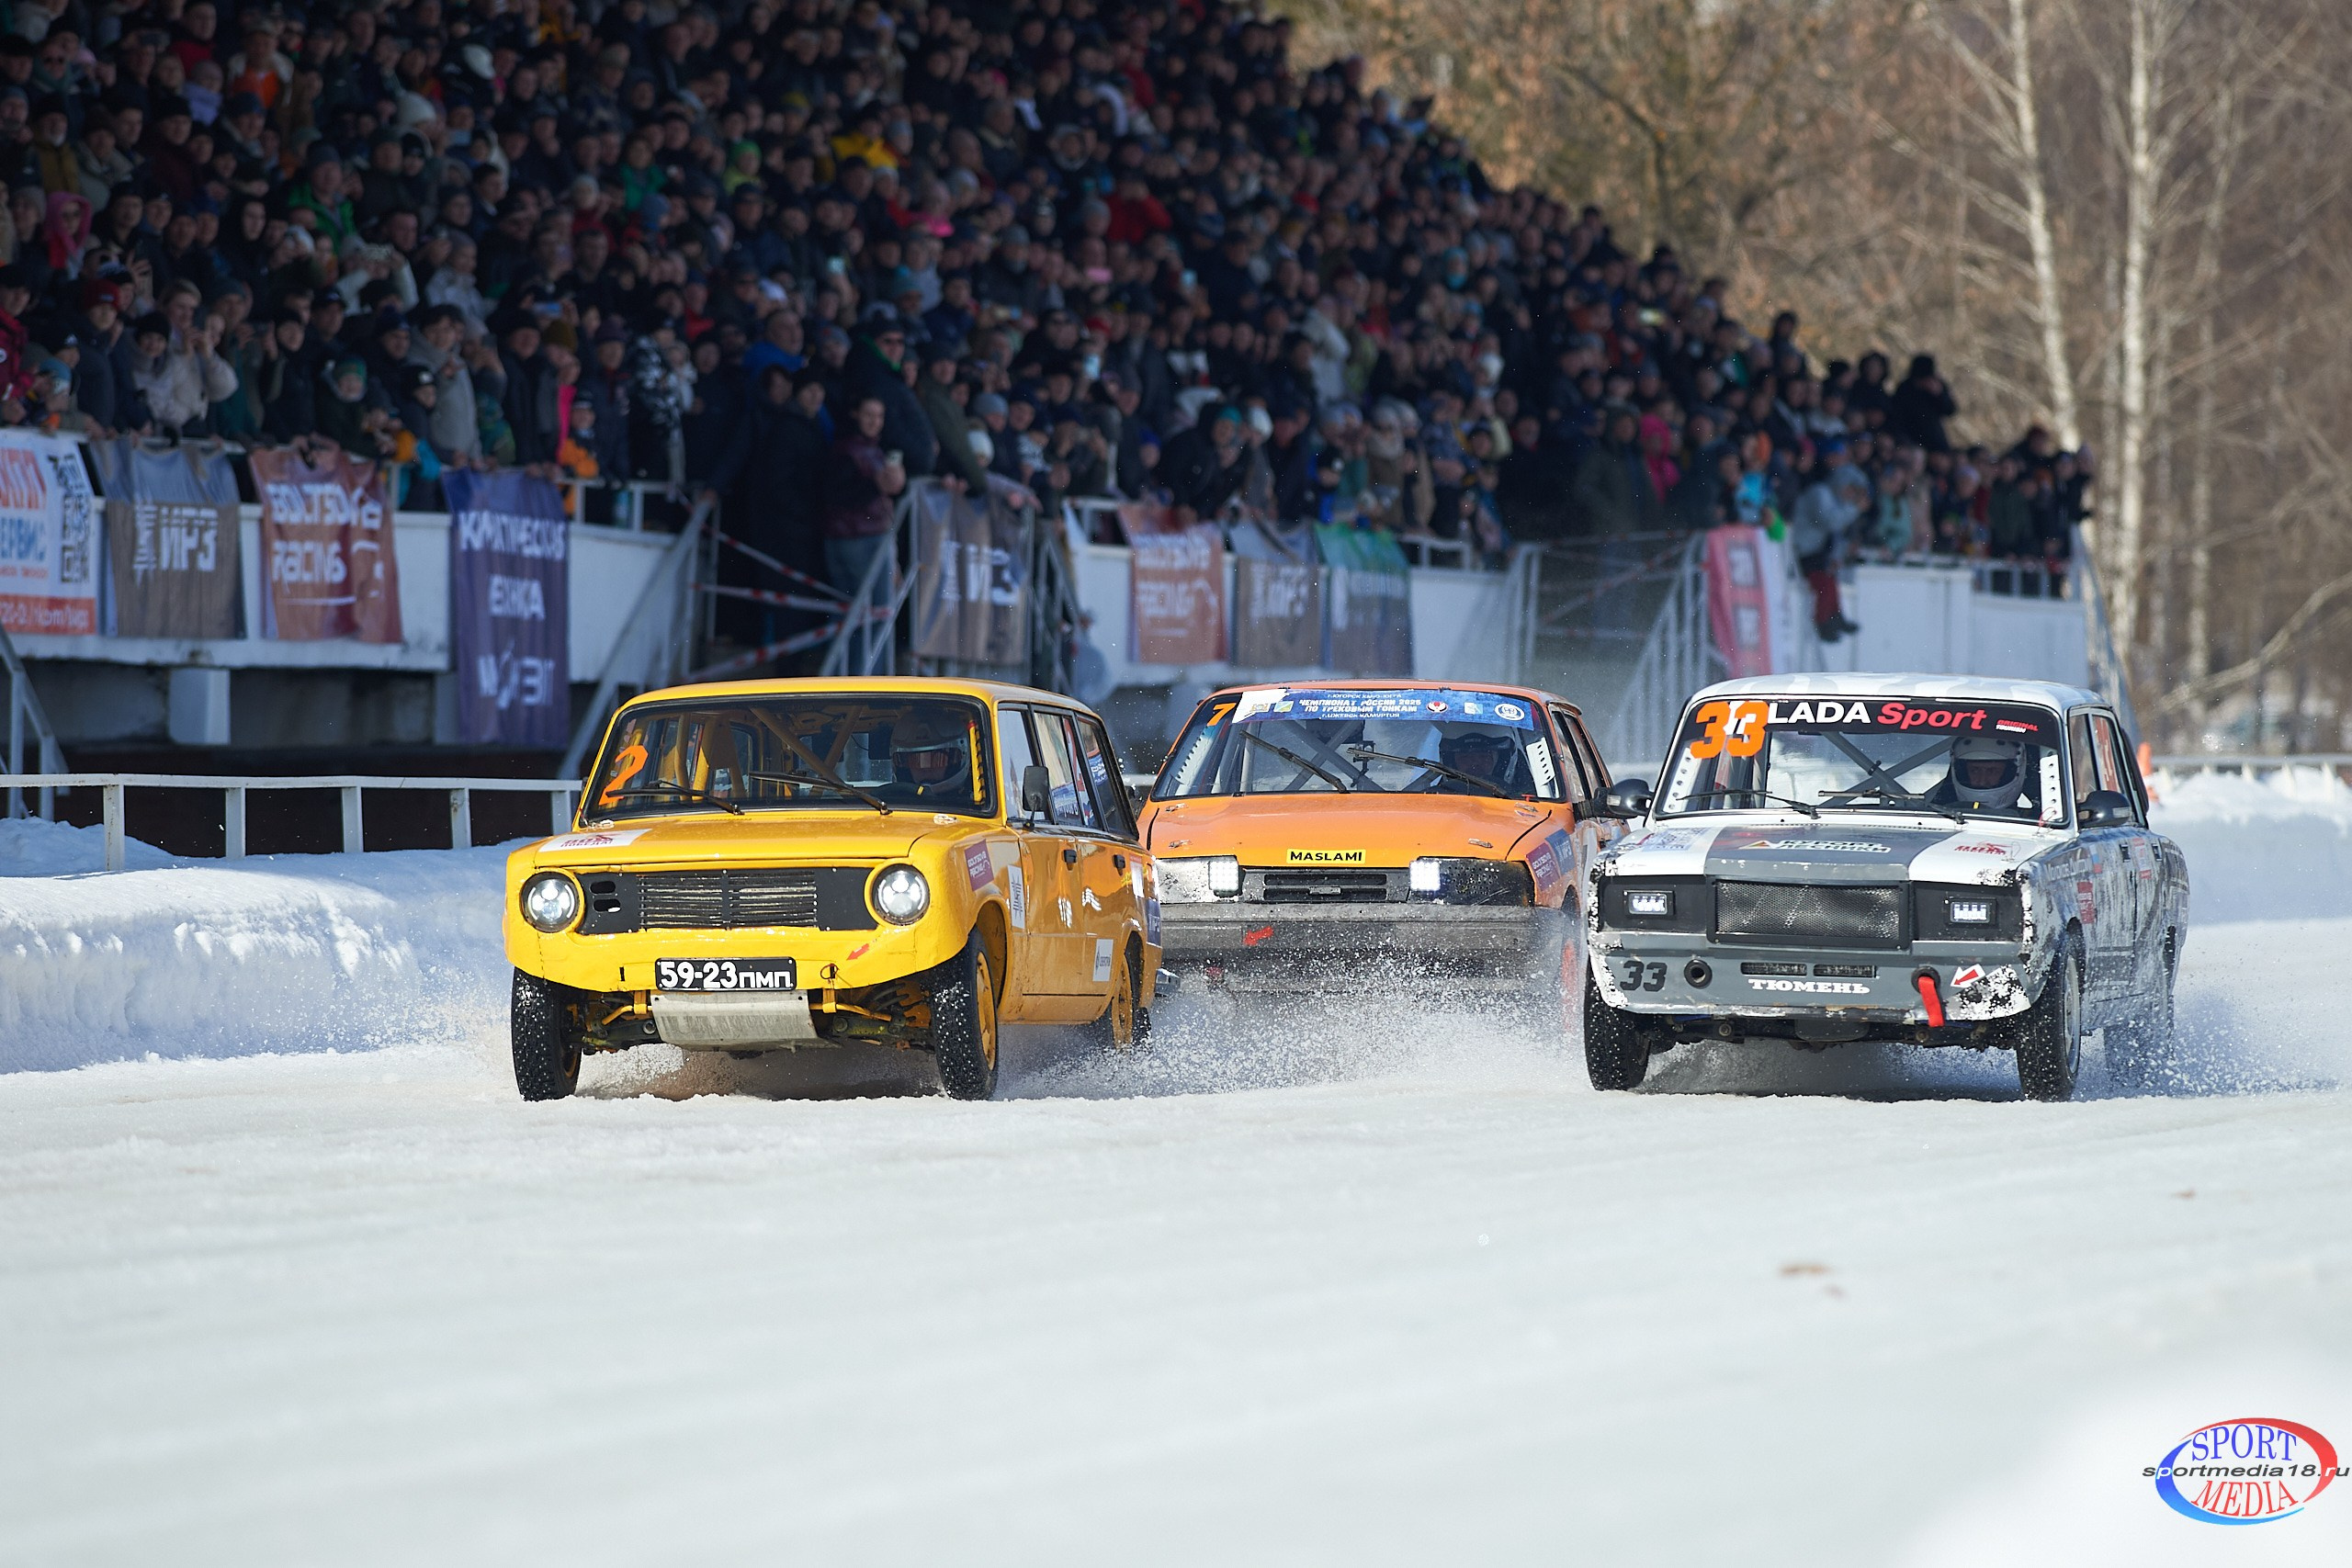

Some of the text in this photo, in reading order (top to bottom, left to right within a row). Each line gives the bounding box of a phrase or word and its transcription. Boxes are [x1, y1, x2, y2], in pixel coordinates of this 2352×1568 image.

[1207, 702, 1238, 727] 7
[1768, 702, 1987, 730] LADA Sport
[1690, 701, 1770, 759] 33
[598, 744, 649, 806] 2
[1290, 851, 1363, 862] MASLAMI
[1620, 960, 1668, 992] 33
[1747, 978, 1871, 994] ТЮМЕНЬ
